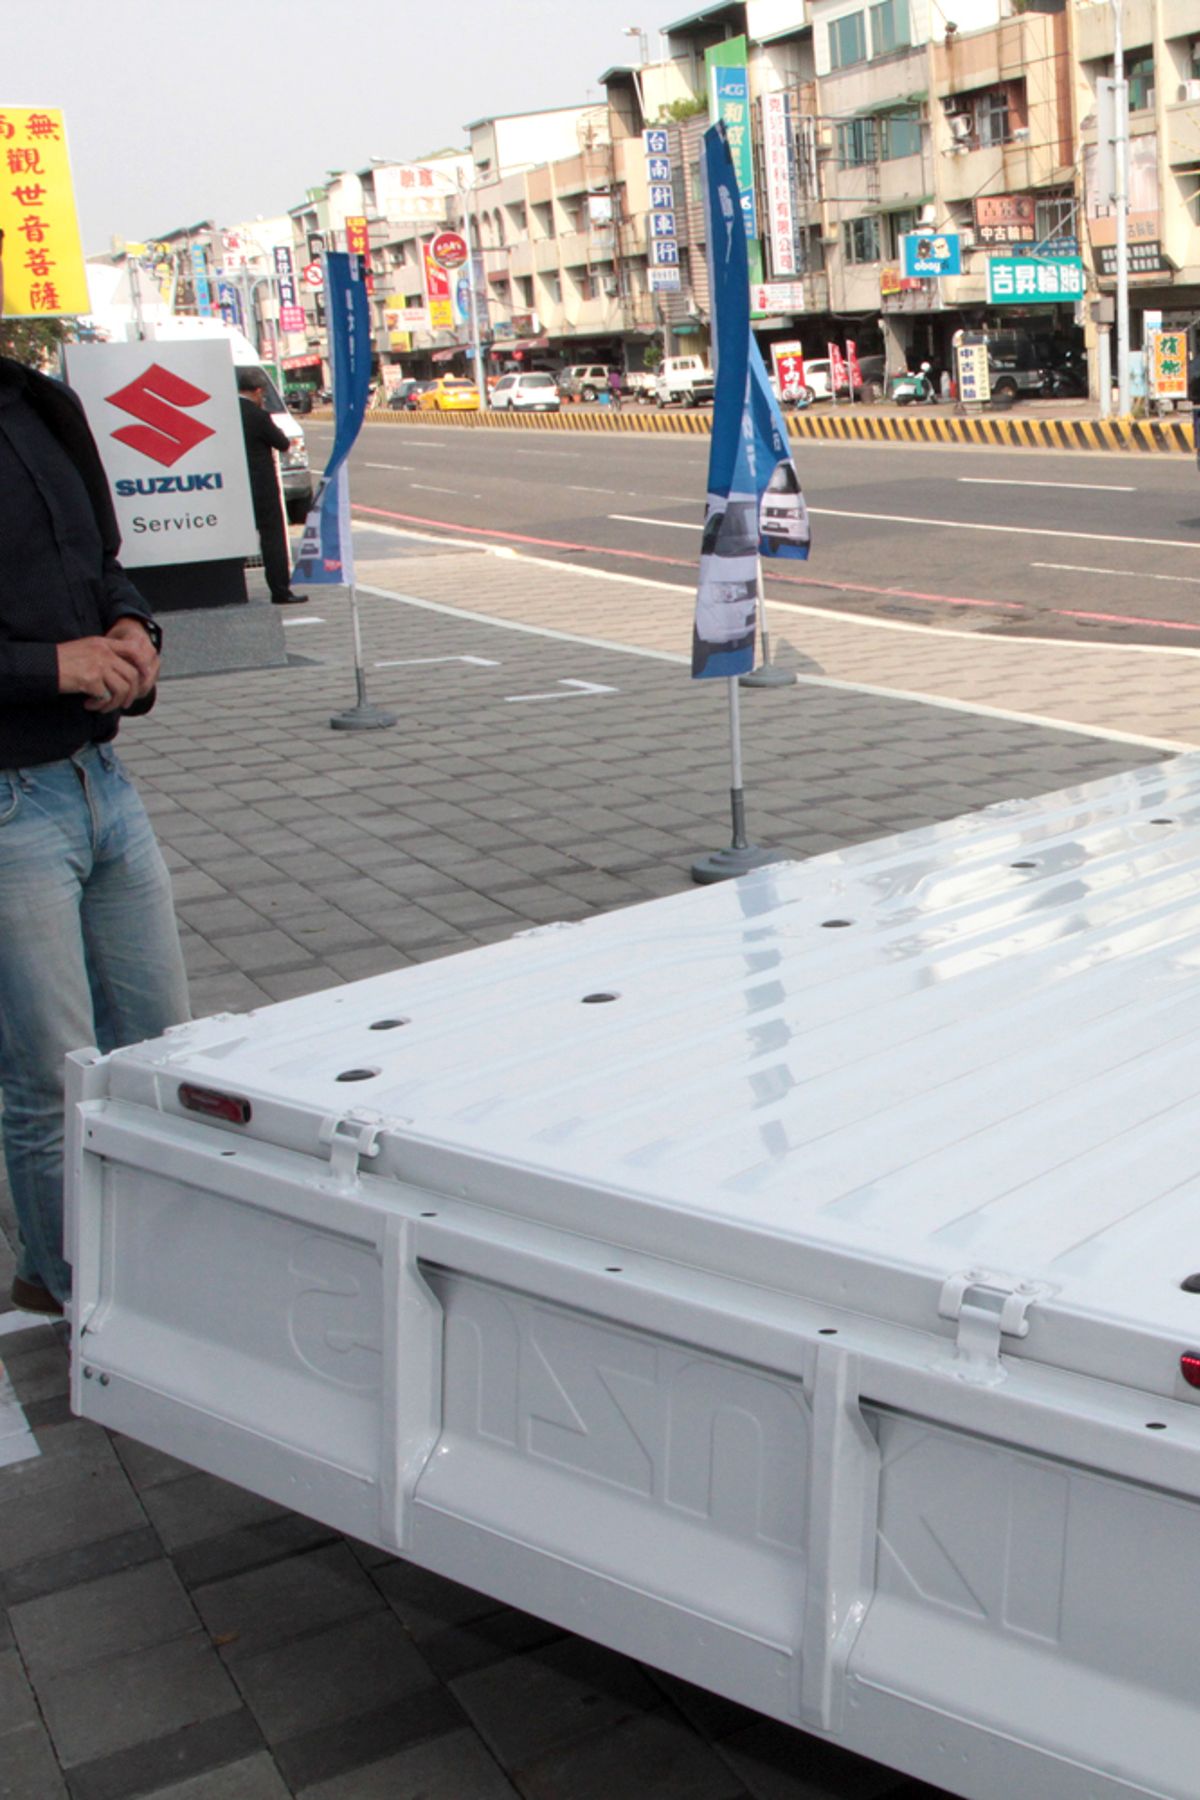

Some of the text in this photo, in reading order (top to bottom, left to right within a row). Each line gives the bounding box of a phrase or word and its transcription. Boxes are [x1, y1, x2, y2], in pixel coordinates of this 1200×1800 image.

[650, 132, 676, 264] 台南針車行
[7, 148, 61, 310] 觀世音菩薩
[992, 265, 1079, 295] 吉昇輪胎
[116, 473, 223, 497] SUZUKI
[132, 513, 218, 533] Service
